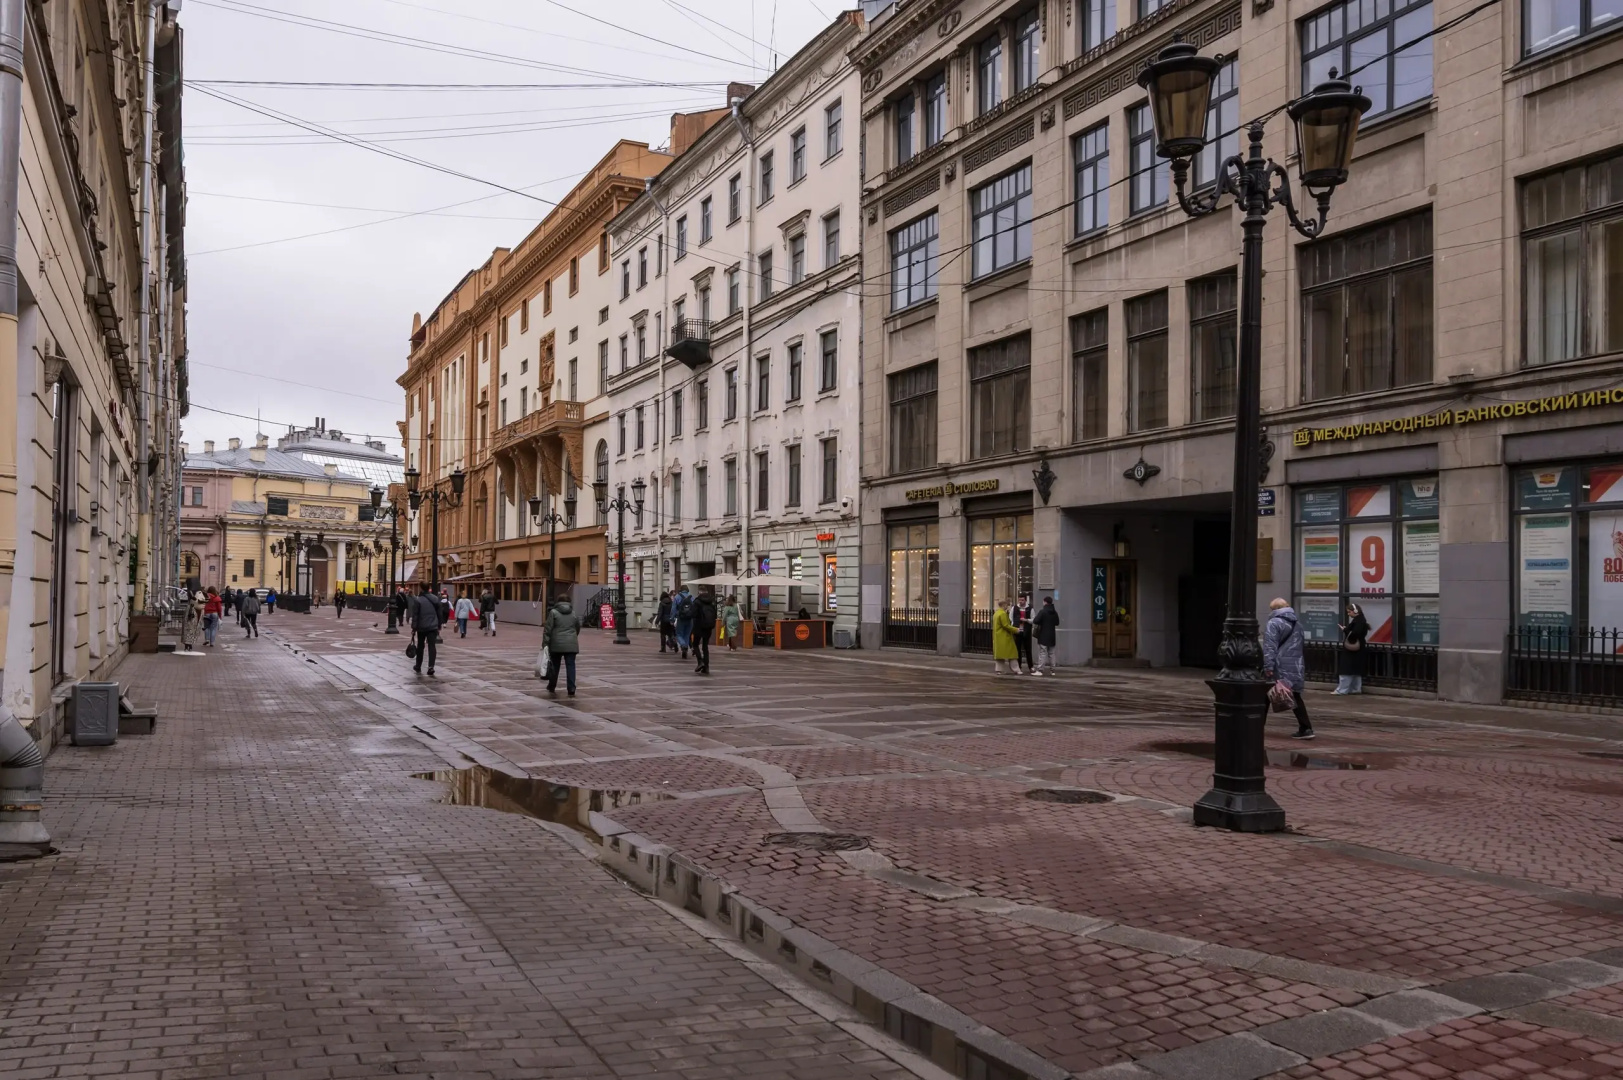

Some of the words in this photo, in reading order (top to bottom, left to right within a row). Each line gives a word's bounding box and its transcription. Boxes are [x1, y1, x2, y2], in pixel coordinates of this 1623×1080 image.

[1314, 410, 1451, 442] МЕЖДУНАРОДНЫЙ
[1454, 392, 1578, 424] БАНКОВСКИЙ
[953, 479, 999, 494] СТОЛОВАЯ
[1134, 466, 1145, 479] 6
[905, 487, 943, 500] CAFETERIA
[1361, 535, 1385, 583] 9
[1094, 567, 1105, 620] КАФЕ
